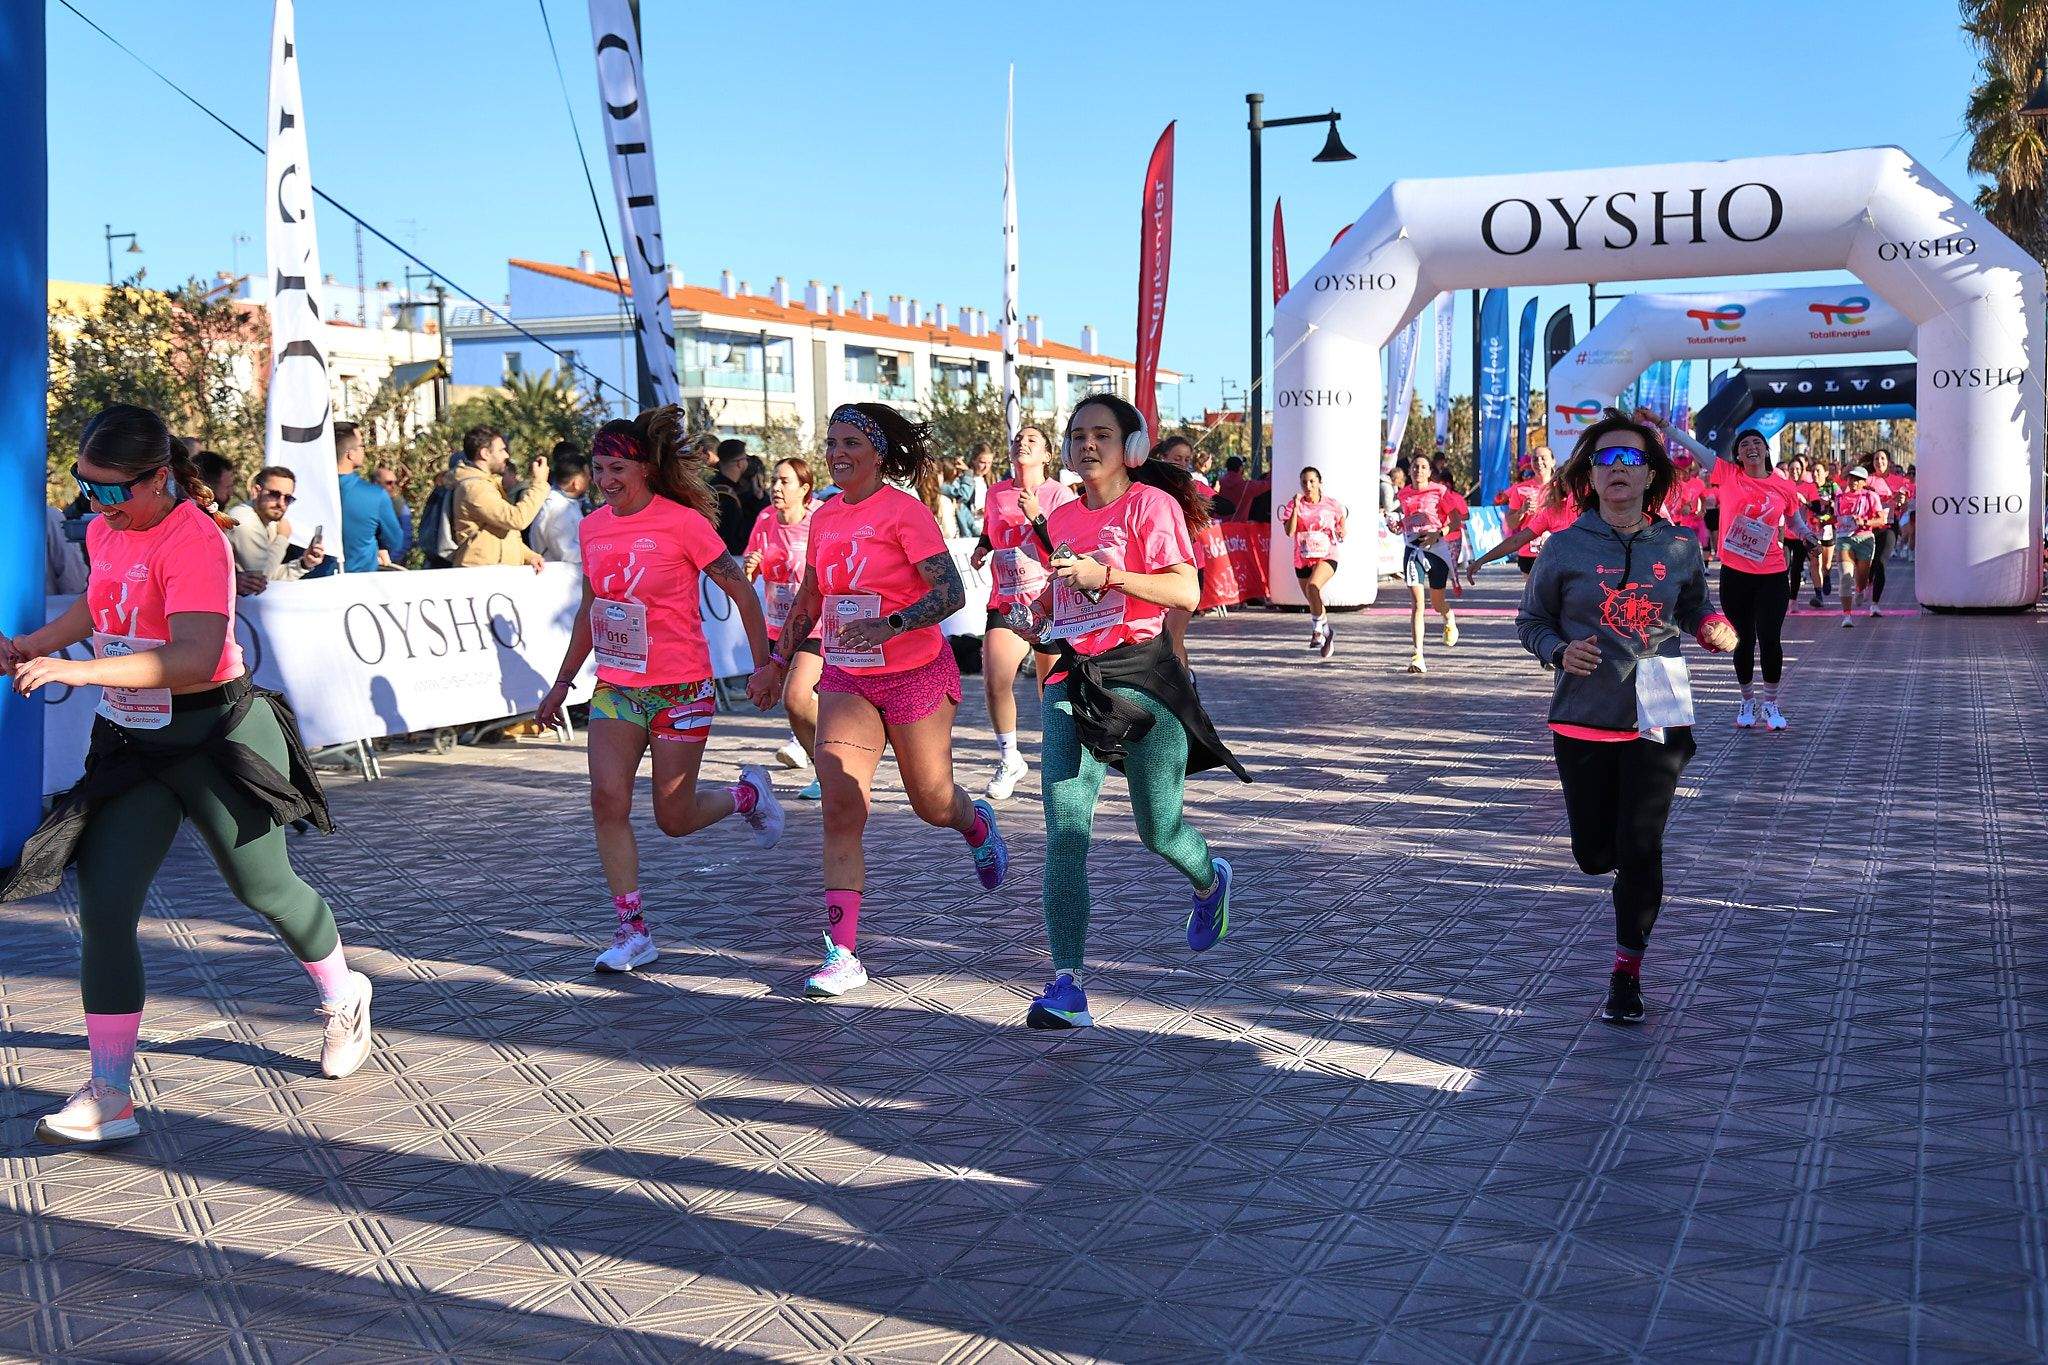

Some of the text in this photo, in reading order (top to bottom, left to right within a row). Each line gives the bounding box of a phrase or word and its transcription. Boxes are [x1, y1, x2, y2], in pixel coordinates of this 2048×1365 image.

[1481, 183, 1783, 255] OYSHO
[1878, 237, 1976, 261] OYSHO
[1315, 273, 1396, 292] OYSHO
[1687, 335, 1746, 345] TotalEnergies
[1809, 328, 1871, 339] TotalEnergies
[1768, 378, 1896, 394] VOLVO
[1933, 367, 2025, 389] OYSHO
[1279, 390, 1352, 408] OYSHO
[1932, 494, 2023, 515] OYSHO
[1742, 534, 1759, 545] 016
[344, 593, 522, 665] OYSHO
[607, 630, 628, 644] 016
